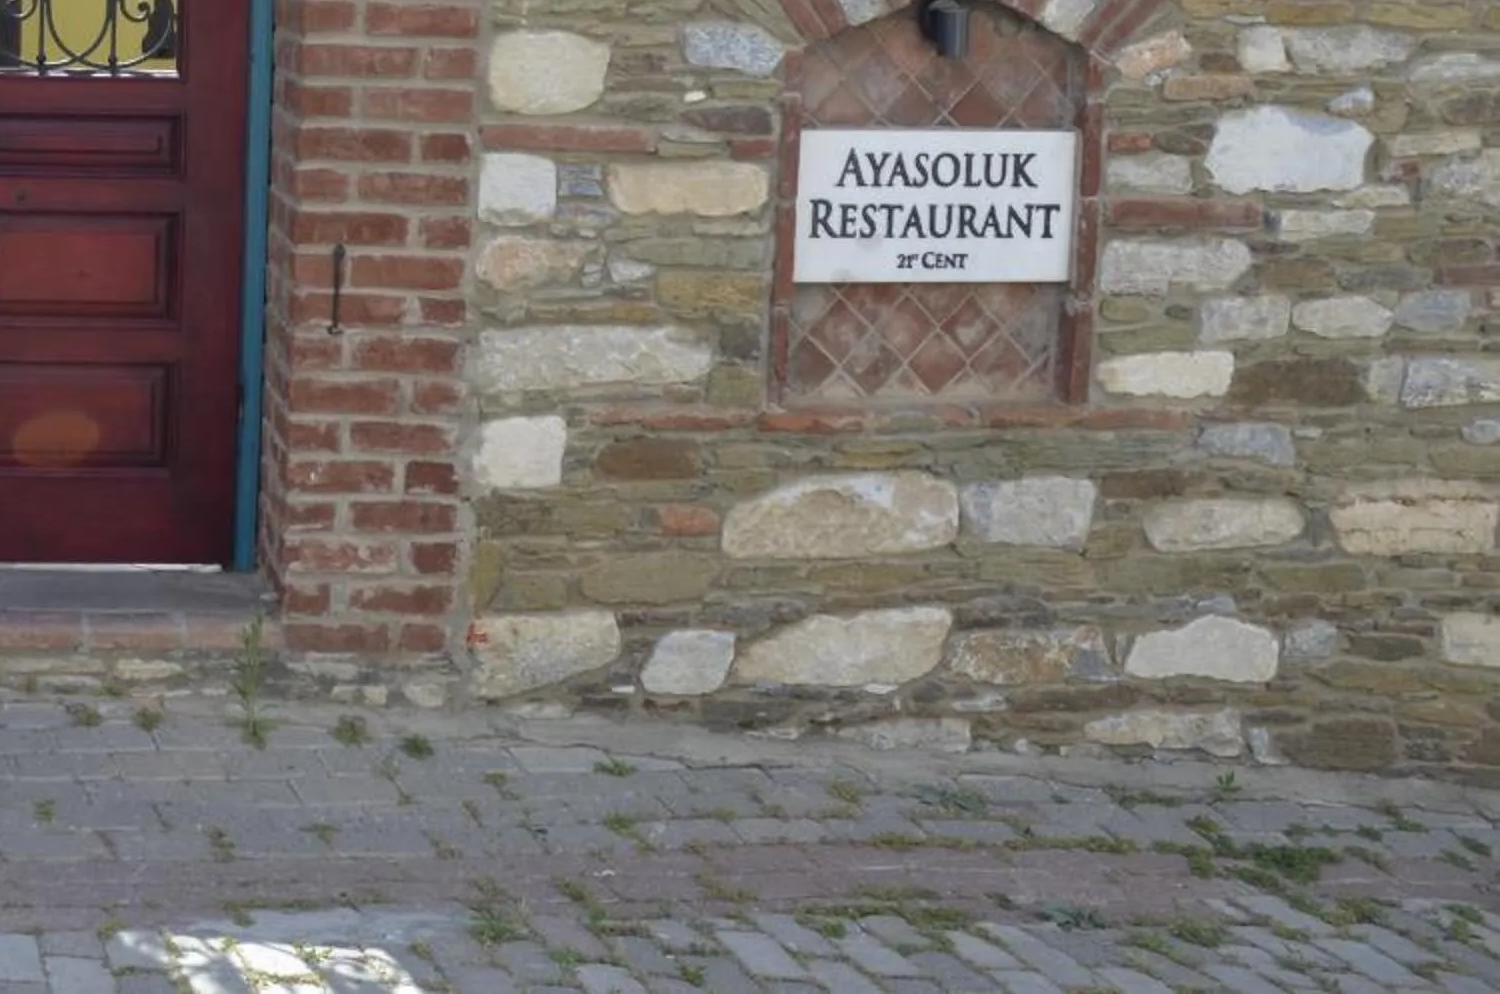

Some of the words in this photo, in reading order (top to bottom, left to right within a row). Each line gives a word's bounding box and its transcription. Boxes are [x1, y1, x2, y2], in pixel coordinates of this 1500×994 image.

[835, 147, 1039, 189] AYASOLUK
[808, 198, 1061, 239] RESTAURANT
[921, 251, 969, 270] CENT
